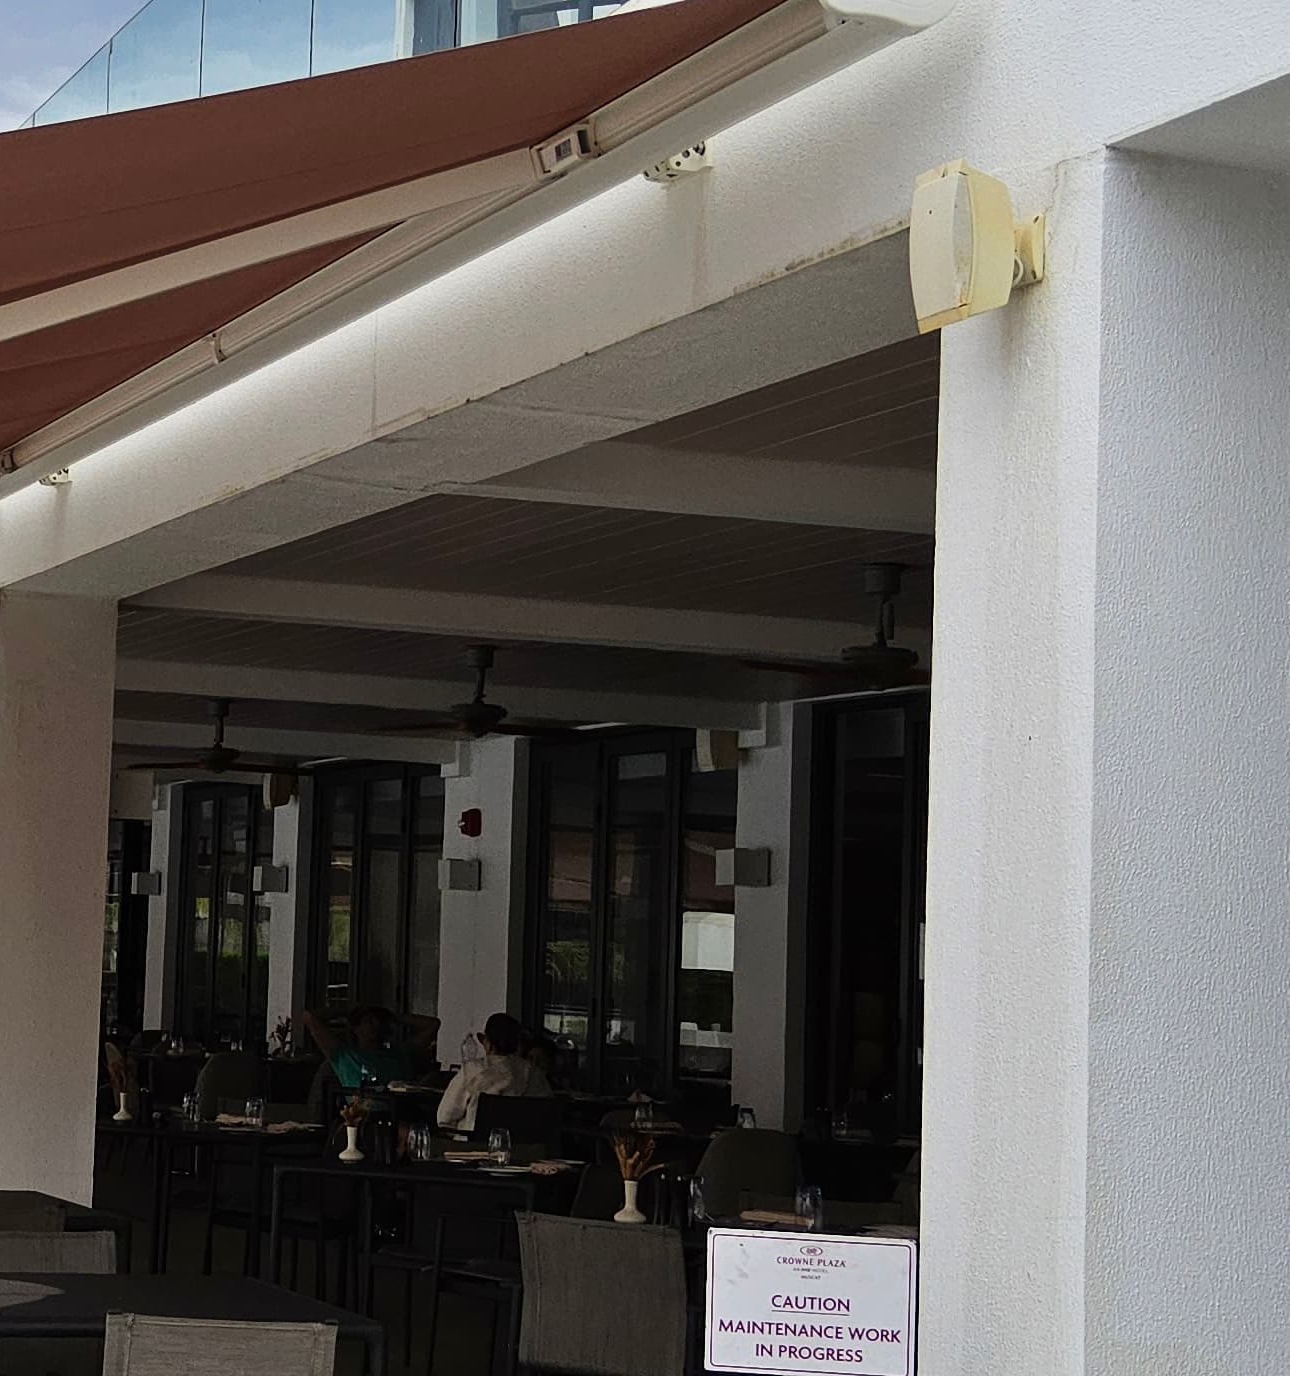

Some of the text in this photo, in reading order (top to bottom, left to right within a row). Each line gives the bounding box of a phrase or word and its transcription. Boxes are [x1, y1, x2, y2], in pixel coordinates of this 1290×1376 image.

[776, 1256, 846, 1268] CROWNE PLAZA
[771, 1294, 850, 1312] CAUTION
[718, 1318, 901, 1343] MAINTENANCE WORK
[755, 1343, 863, 1363] IN PROGRESS
